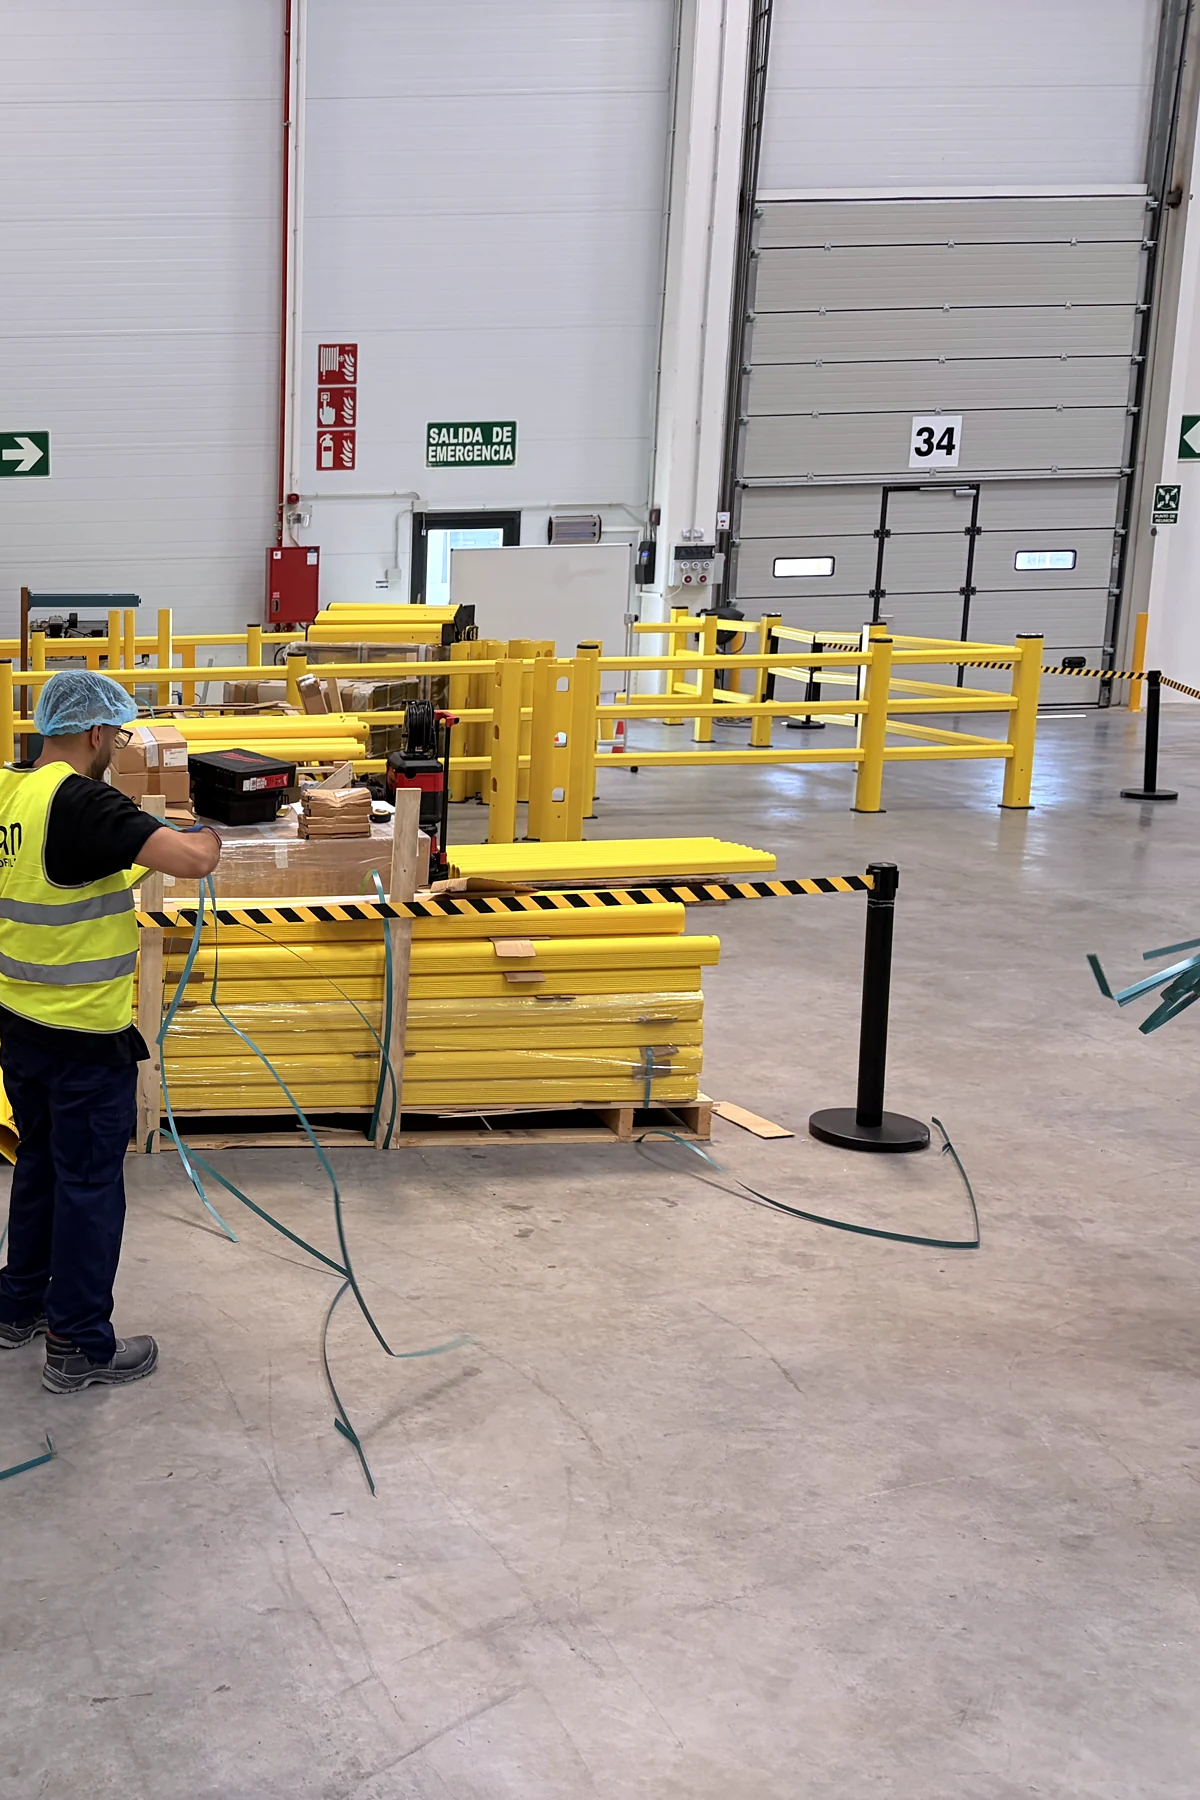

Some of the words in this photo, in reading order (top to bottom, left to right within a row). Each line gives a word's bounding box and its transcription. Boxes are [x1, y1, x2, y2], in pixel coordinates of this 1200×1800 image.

[429, 427, 484, 444] SALIDA
[492, 426, 512, 443] DE
[914, 426, 956, 457] 34
[428, 444, 514, 462] EMERGENCIA
